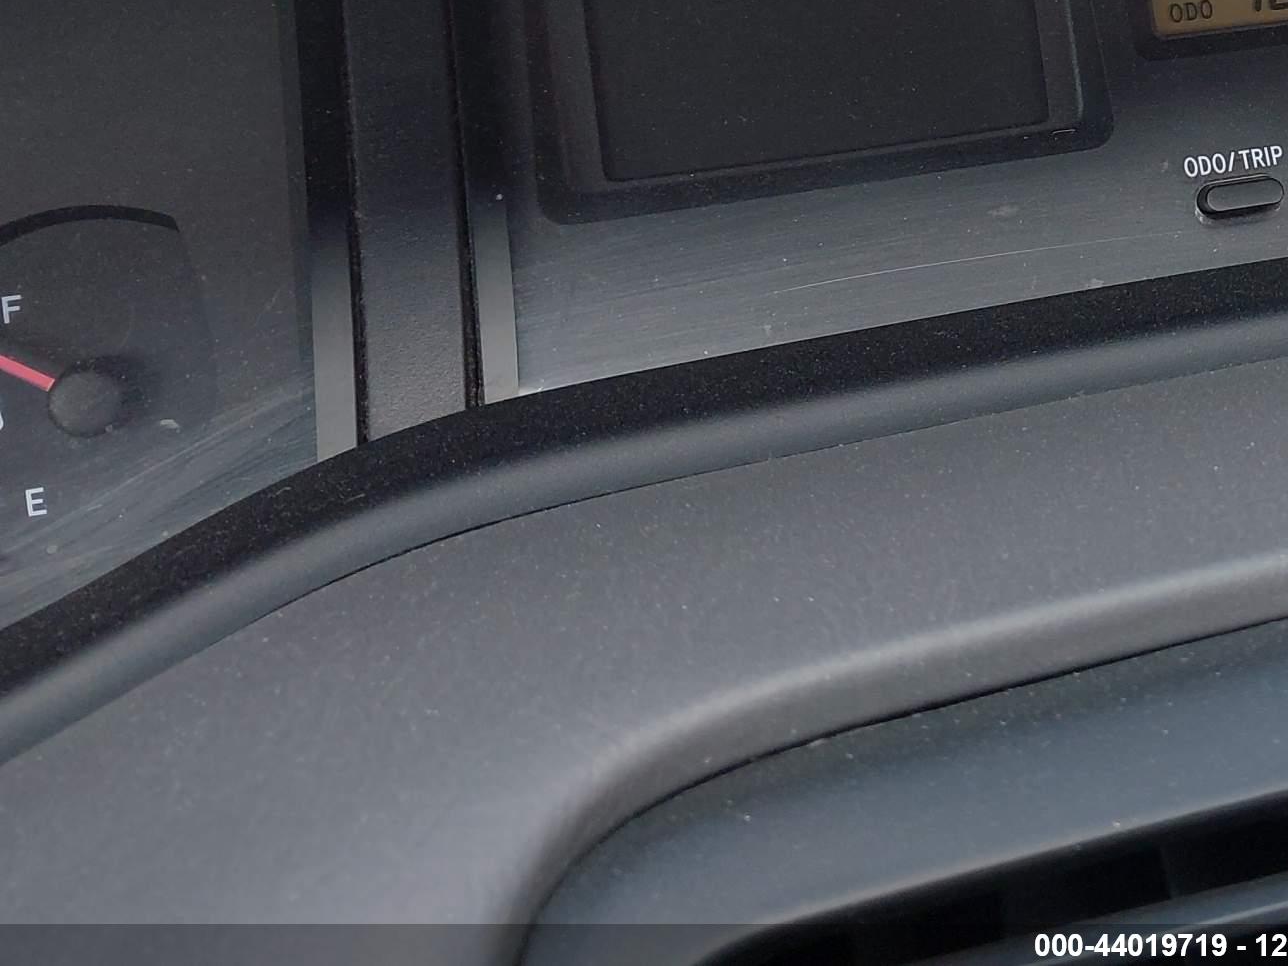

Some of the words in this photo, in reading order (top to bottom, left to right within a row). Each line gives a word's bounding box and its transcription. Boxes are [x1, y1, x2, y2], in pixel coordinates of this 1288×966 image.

[1169, 0, 1213, 23] ODO
[1183, 145, 1283, 178] ODO/TRIP
[1, 295, 22, 324] F
[25, 487, 48, 517] E
